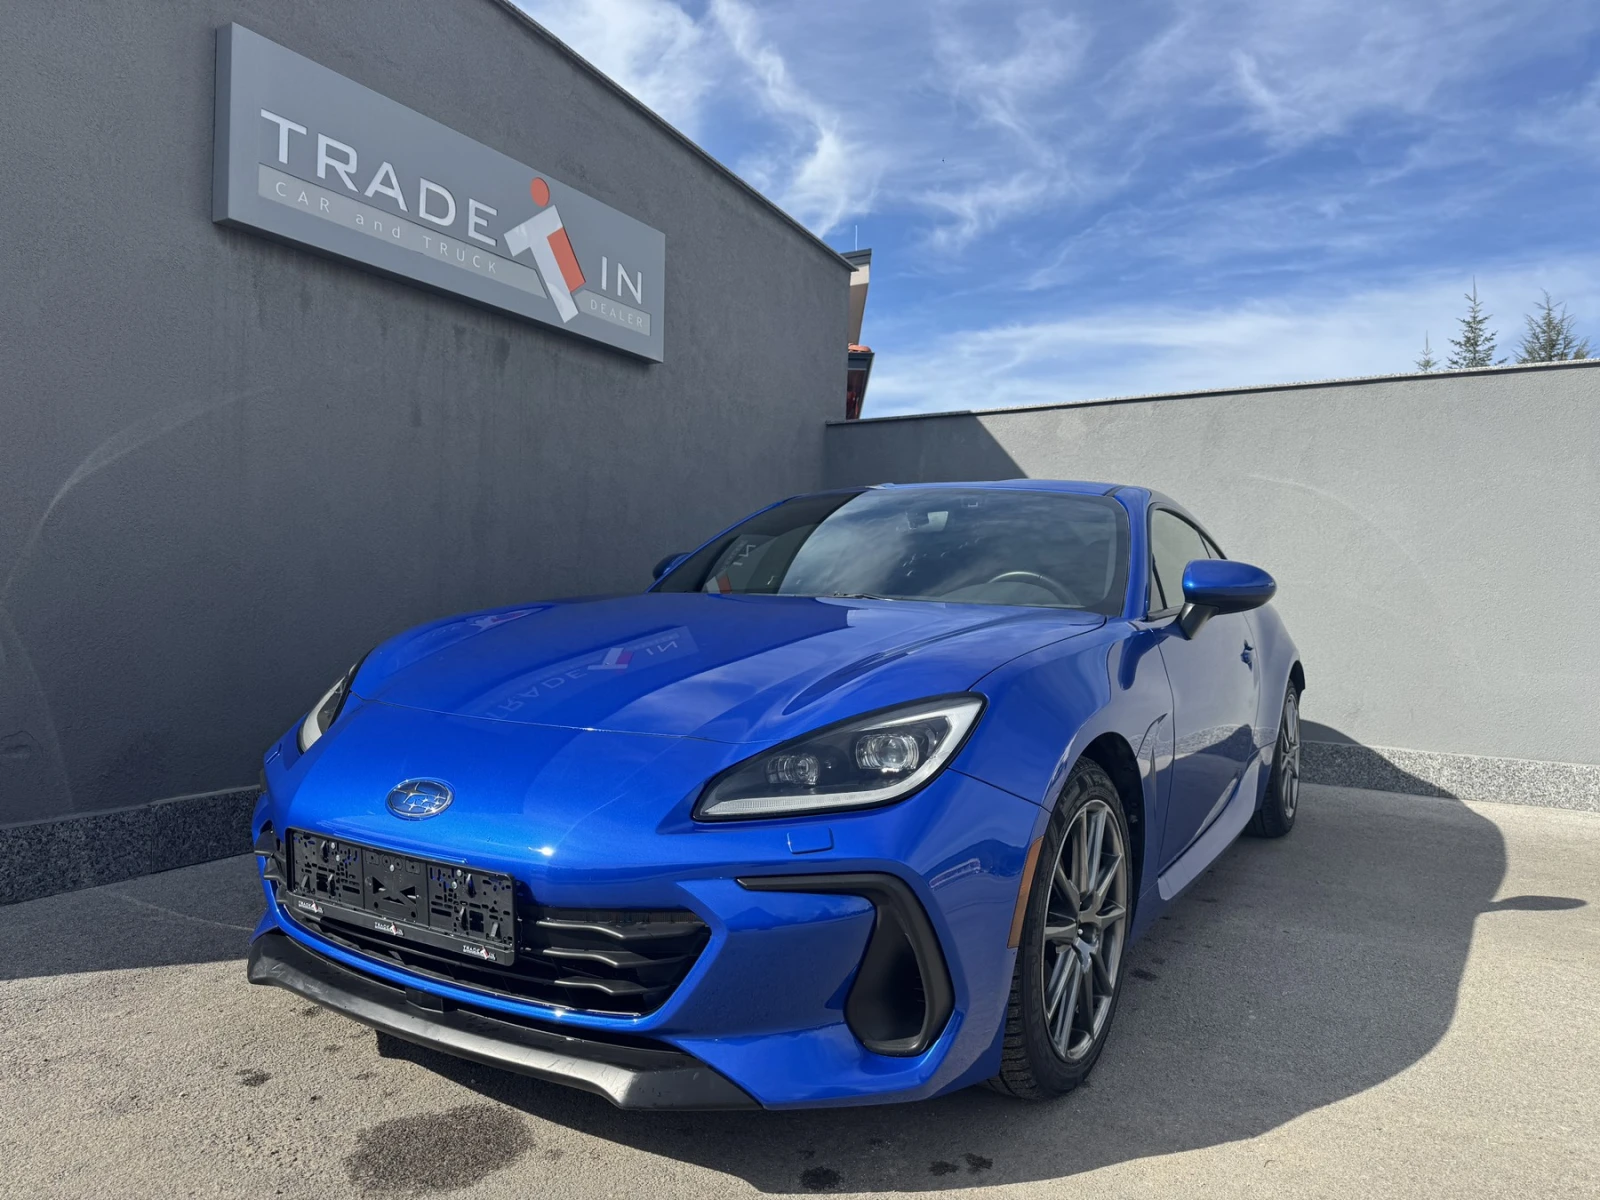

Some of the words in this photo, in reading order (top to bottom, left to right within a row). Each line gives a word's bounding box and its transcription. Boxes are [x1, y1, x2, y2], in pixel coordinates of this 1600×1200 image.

[260, 107, 497, 247] TRADE
[602, 256, 642, 304] IN
[275, 181, 330, 213] CAR
[355, 213, 401, 239] and
[422, 235, 497, 274] TRUCK
[590, 299, 643, 328] DEALER
